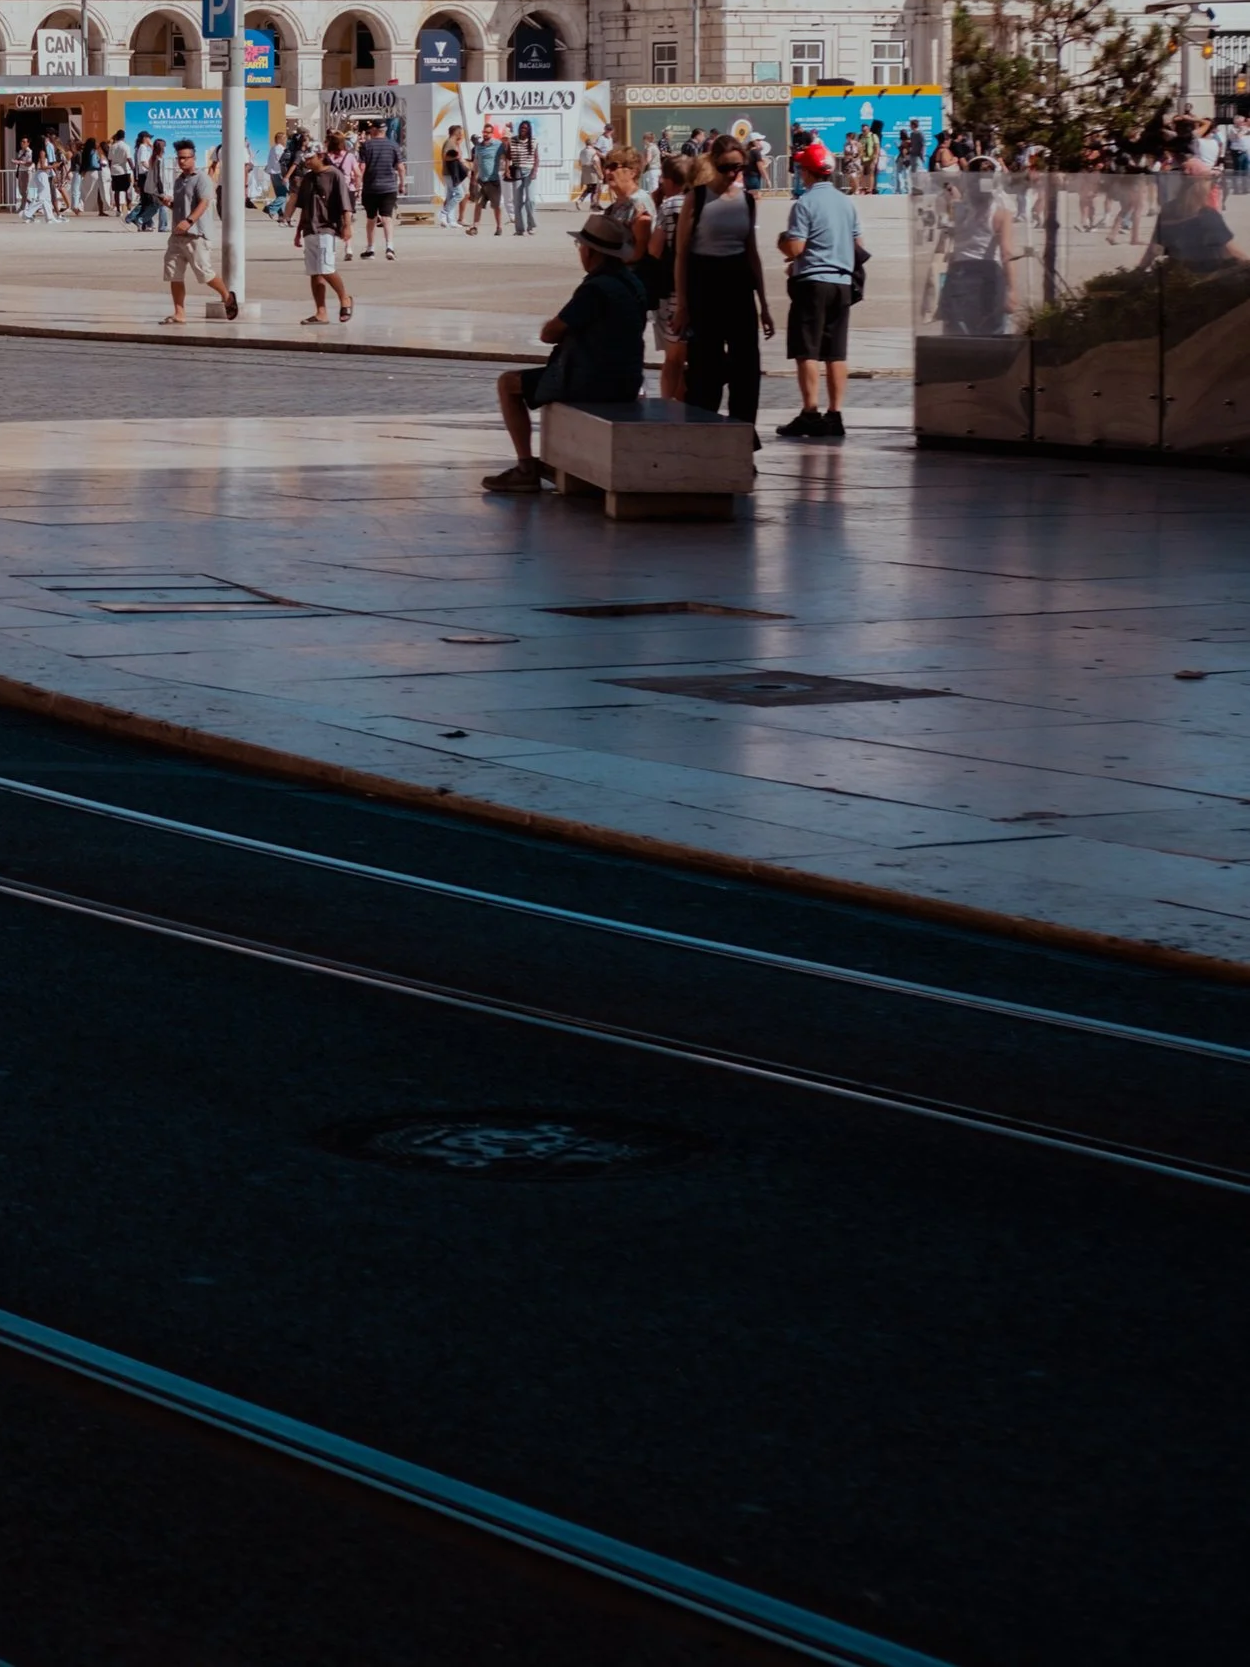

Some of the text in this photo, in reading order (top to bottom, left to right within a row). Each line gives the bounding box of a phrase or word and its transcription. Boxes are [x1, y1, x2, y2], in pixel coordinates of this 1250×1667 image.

[45, 36, 75, 53] CAN
[46, 61, 76, 76] CAN
[15, 94, 51, 108] GALAXY
[148, 107, 199, 120] GALAXY
